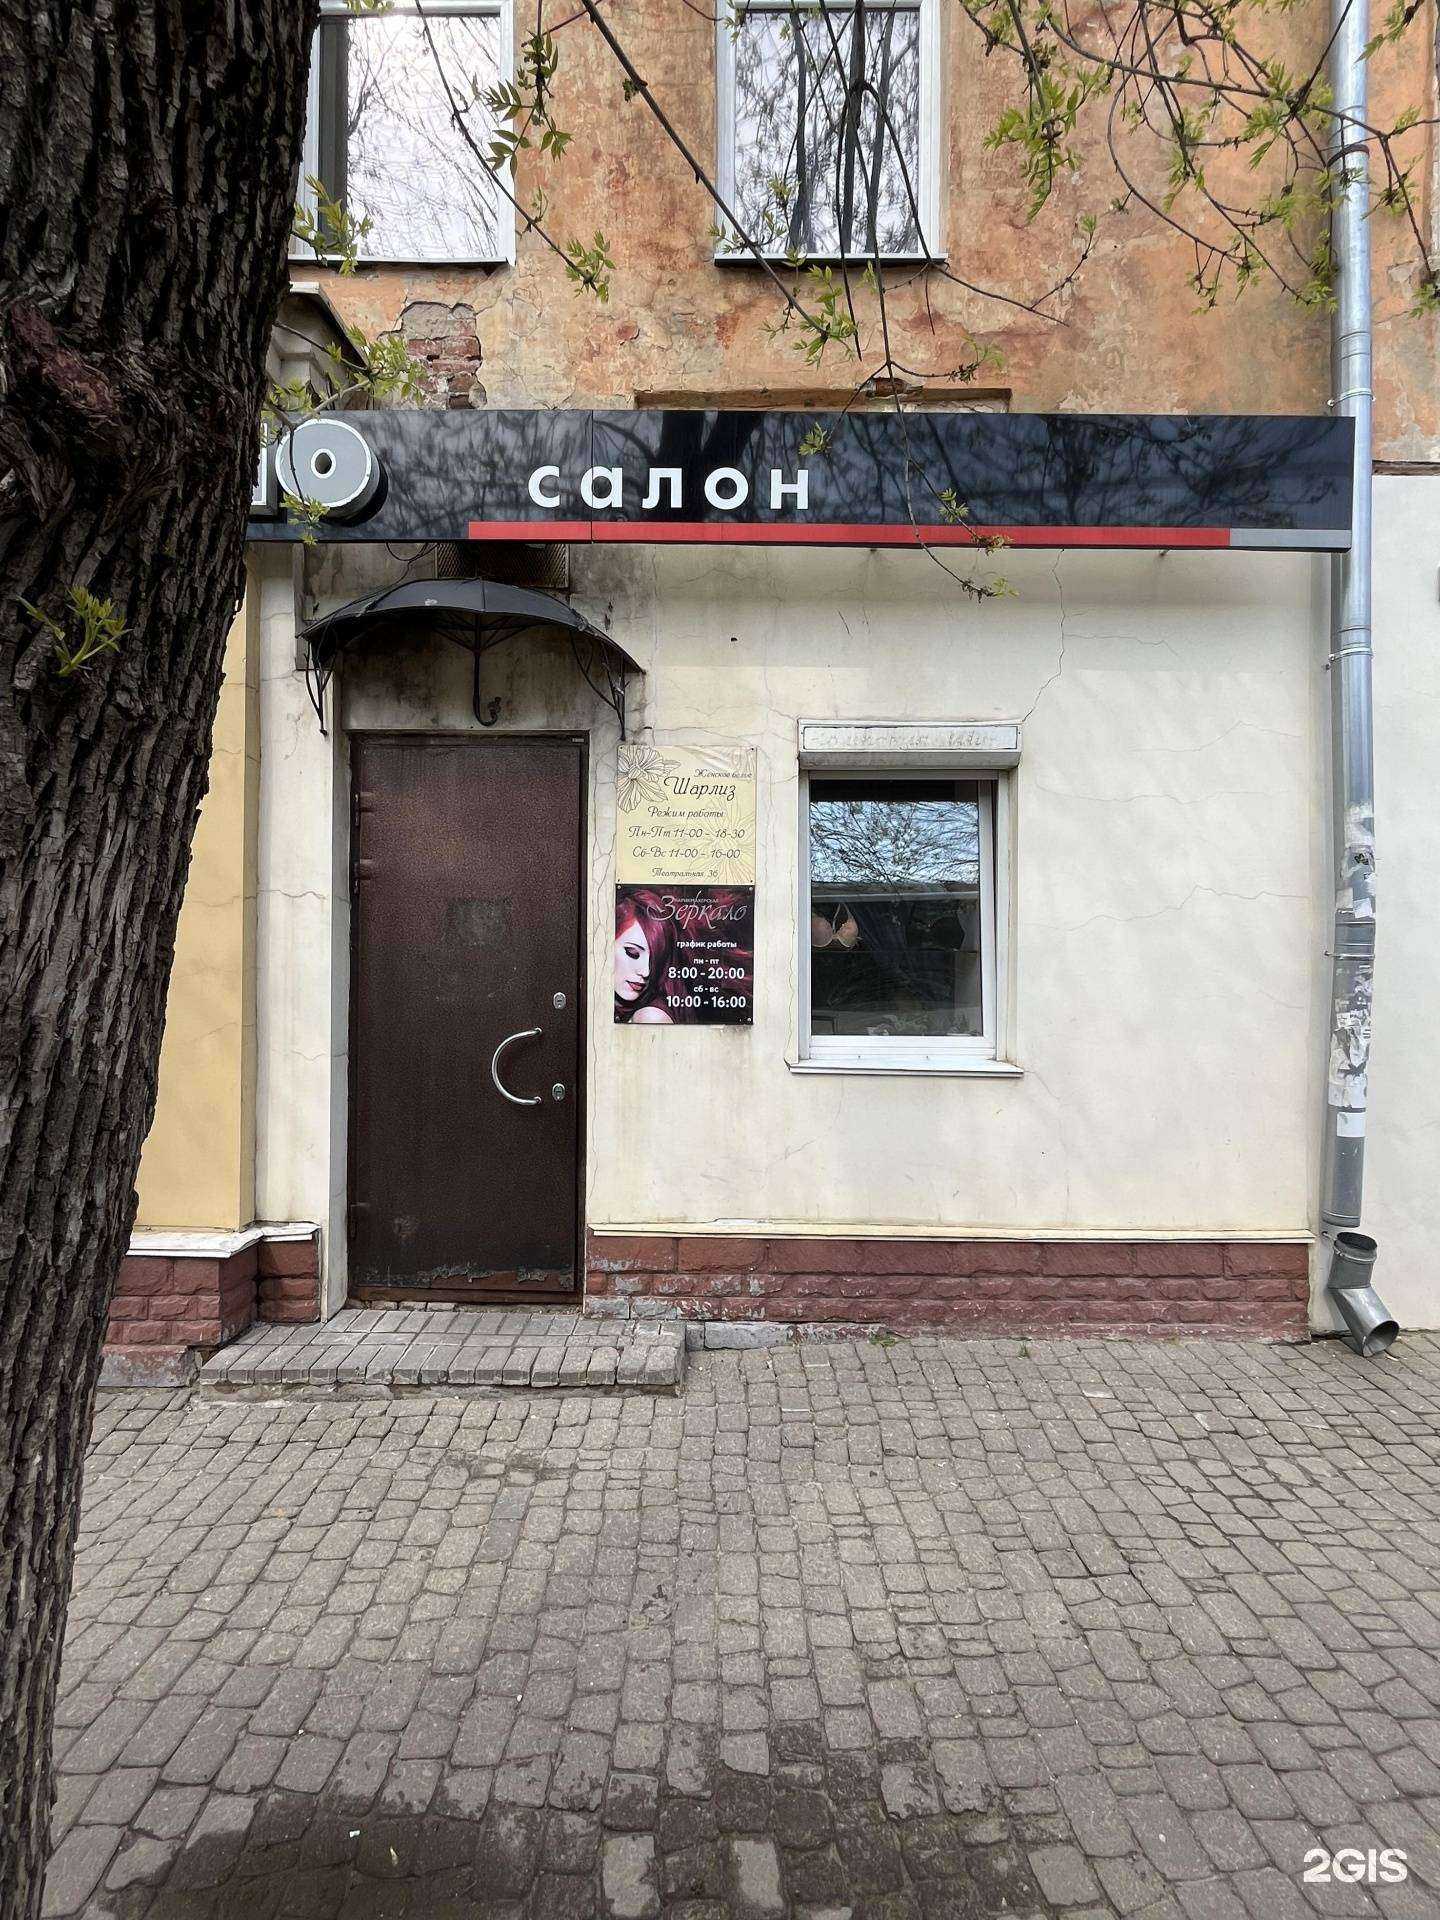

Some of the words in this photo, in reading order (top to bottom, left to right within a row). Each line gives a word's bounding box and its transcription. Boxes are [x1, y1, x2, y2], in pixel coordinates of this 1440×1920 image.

[528, 465, 809, 510] салон
[664, 776, 737, 801] Шарлиз
[648, 805, 686, 818] Режим
[687, 808, 724, 819] работы
[628, 826, 671, 838] Пн-Пт
[673, 828, 703, 838] 11-00
[715, 828, 745, 839] 18-30
[632, 846, 666, 858] Сб-Вс
[669, 848, 699, 858] 11-00
[652, 867, 705, 878] Театральная
[647, 891, 748, 930] Зеркало
[677, 940, 706, 949] график
[707, 940, 737, 949] работы
[668, 967, 698, 979] 8:00
[708, 967, 745, 979] 20:00
[666, 996, 700, 1008] 10:00
[711, 996, 746, 1008] 16:00
